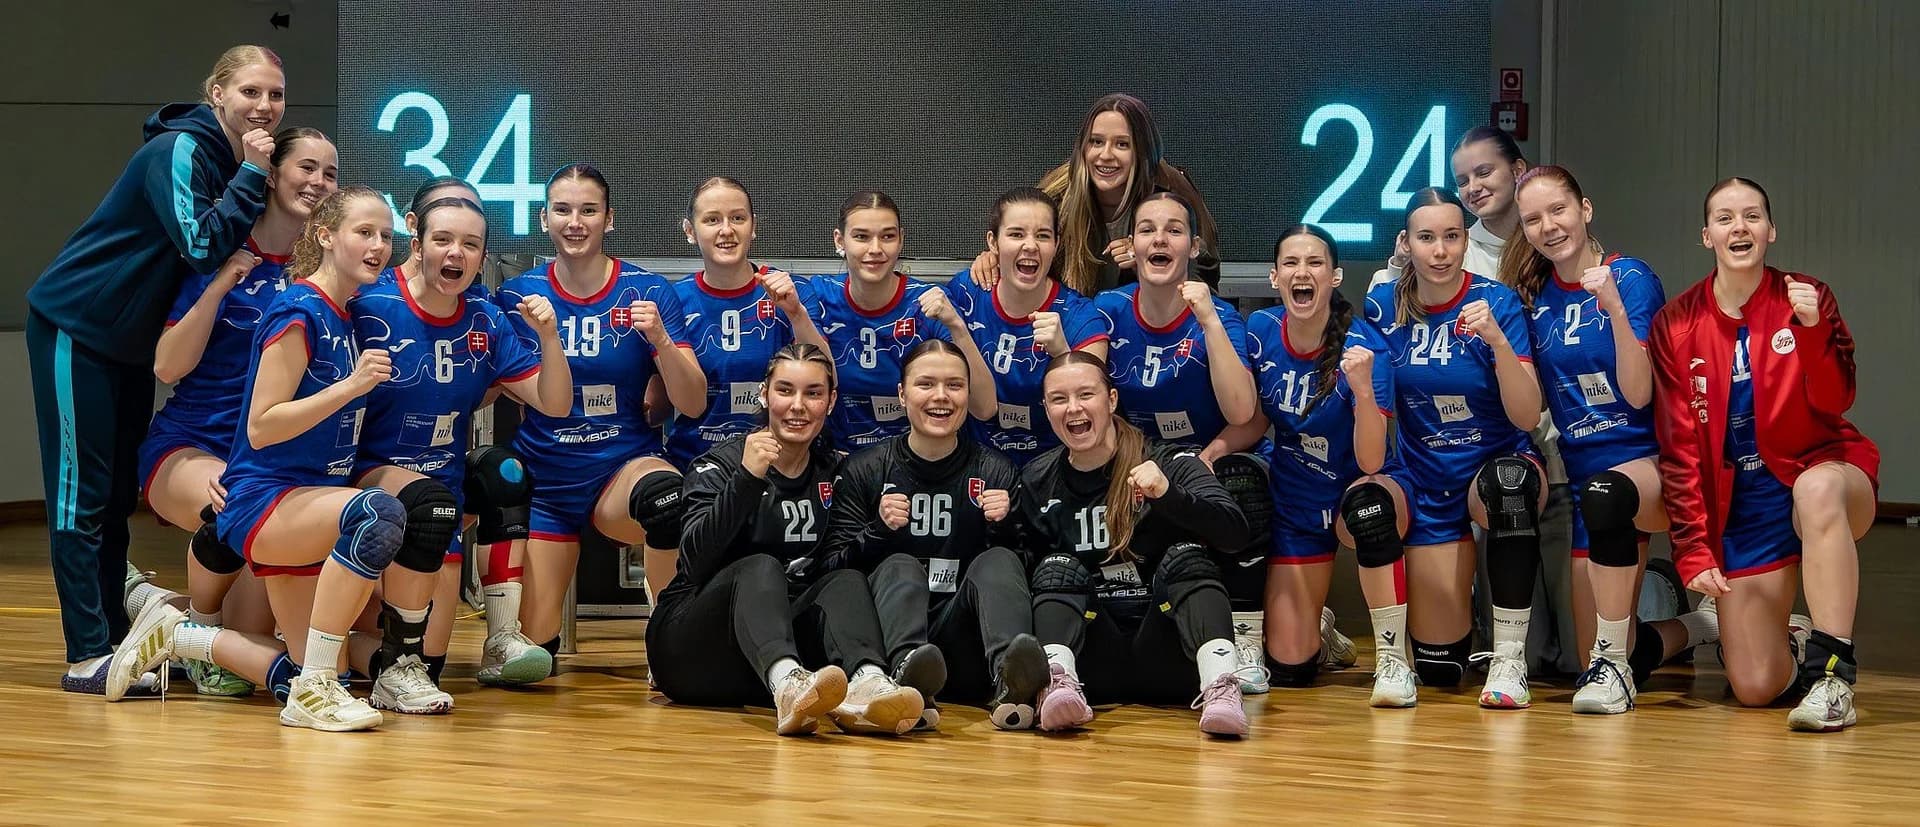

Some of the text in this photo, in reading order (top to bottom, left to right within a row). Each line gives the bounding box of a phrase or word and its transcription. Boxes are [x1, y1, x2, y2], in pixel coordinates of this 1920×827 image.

[377, 91, 546, 236] 34
[1300, 103, 1460, 241] 24
[562, 315, 601, 357] 19
[721, 309, 742, 352] 9
[1410, 323, 1452, 366] 24
[1564, 303, 1583, 346] 2
[434, 340, 454, 384] 6
[860, 327, 877, 369] 3
[993, 333, 1017, 375] 8
[1142, 345, 1164, 388] 5
[1732, 336, 1752, 383] 1
[587, 393, 613, 407] niké
[734, 390, 760, 406] niké
[1278, 370, 1311, 417] 11
[1585, 382, 1609, 397] niké
[578, 428, 620, 443] MBDS
[1002, 412, 1026, 424] niké
[1162, 420, 1188, 433] niké
[655, 491, 679, 507] SELECT
[910, 493, 953, 537] 96
[1357, 504, 1381, 518] SELECT
[781, 499, 818, 543] 22
[1074, 505, 1111, 553] 16
[931, 568, 957, 584] niké
